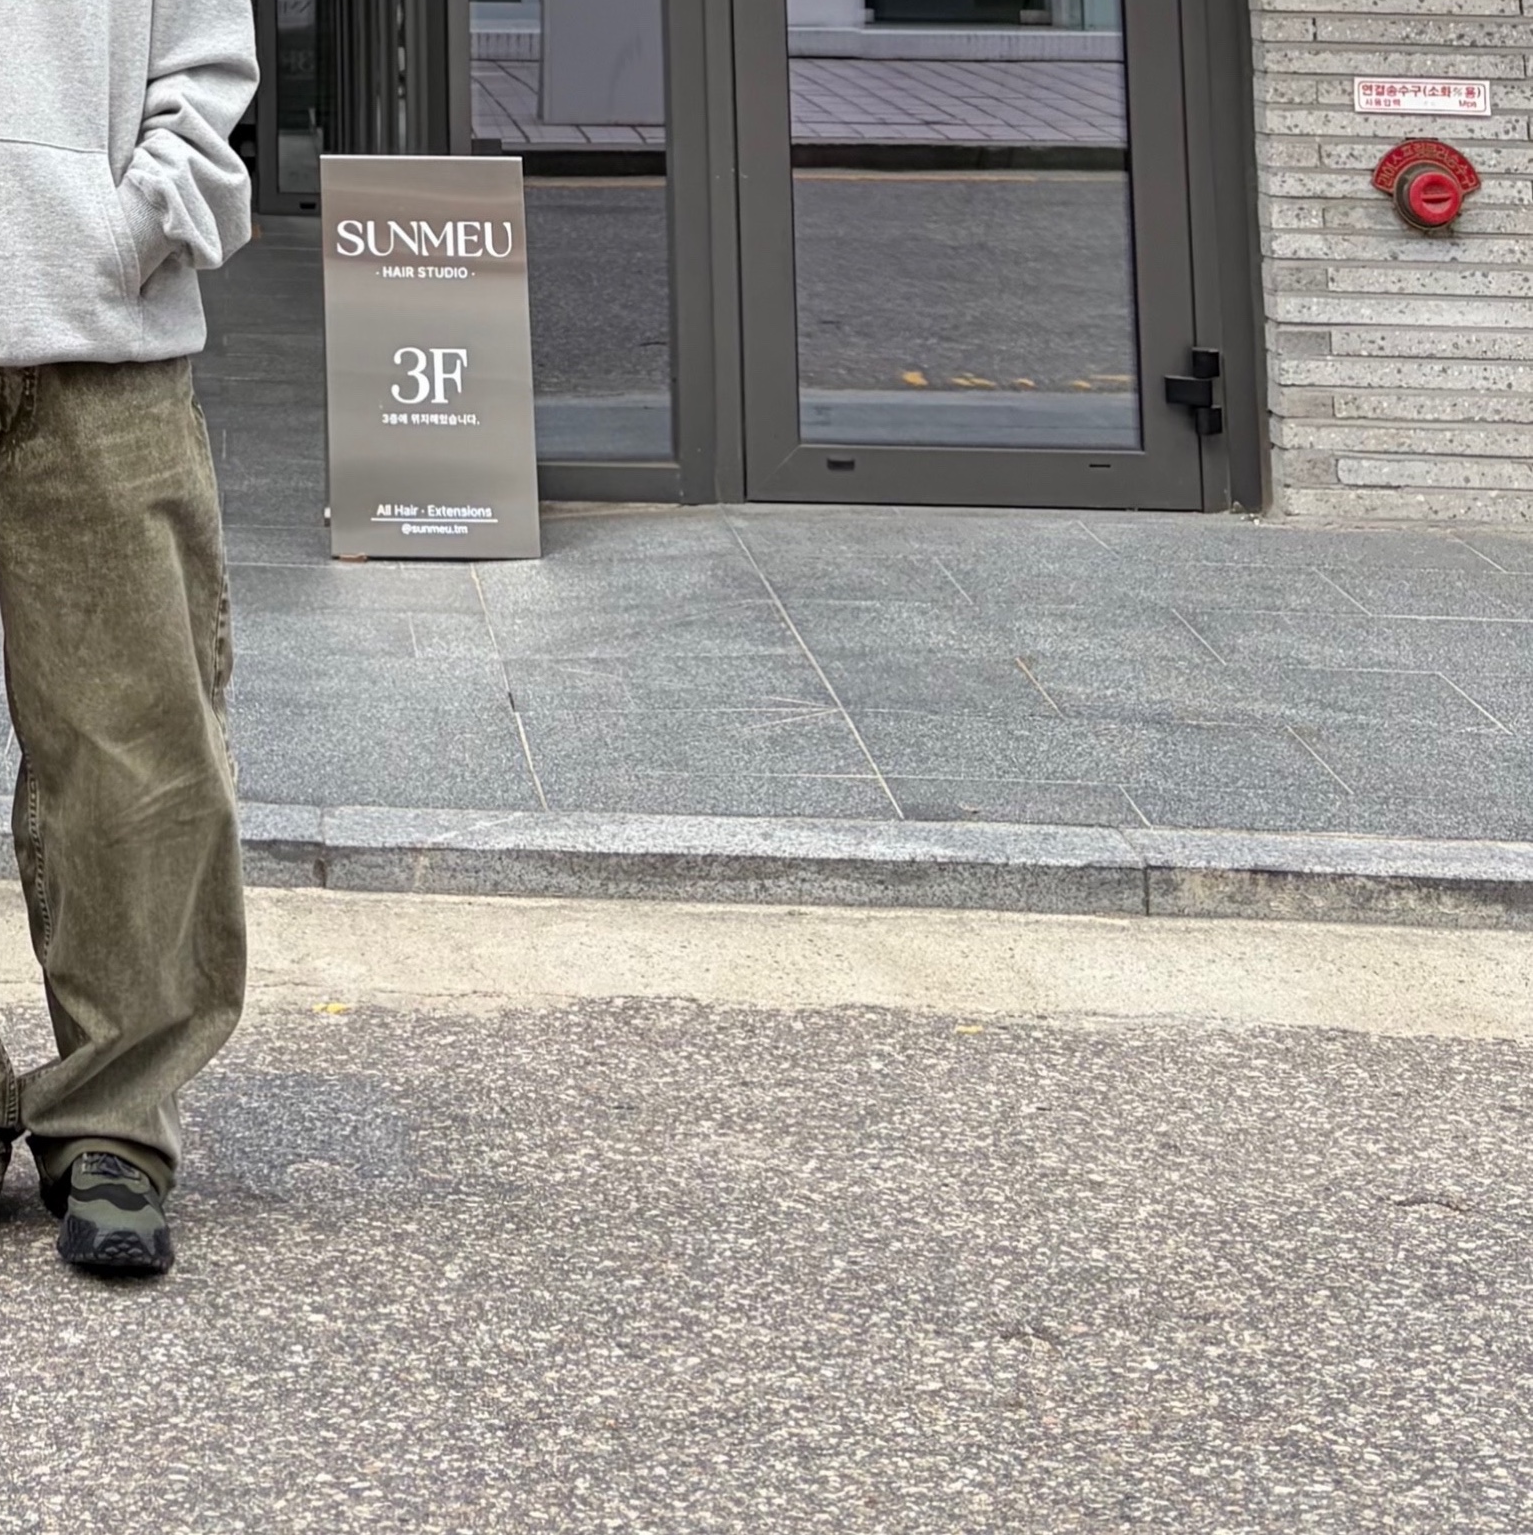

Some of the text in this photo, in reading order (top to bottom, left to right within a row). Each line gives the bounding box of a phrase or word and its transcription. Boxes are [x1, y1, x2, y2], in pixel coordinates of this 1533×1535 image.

[336, 219, 513, 258] SUNMEU
[382, 266, 468, 279] HAIR STUDIO
[390, 347, 468, 405] 3F
[376, 504, 492, 518] All Hair Extensions
